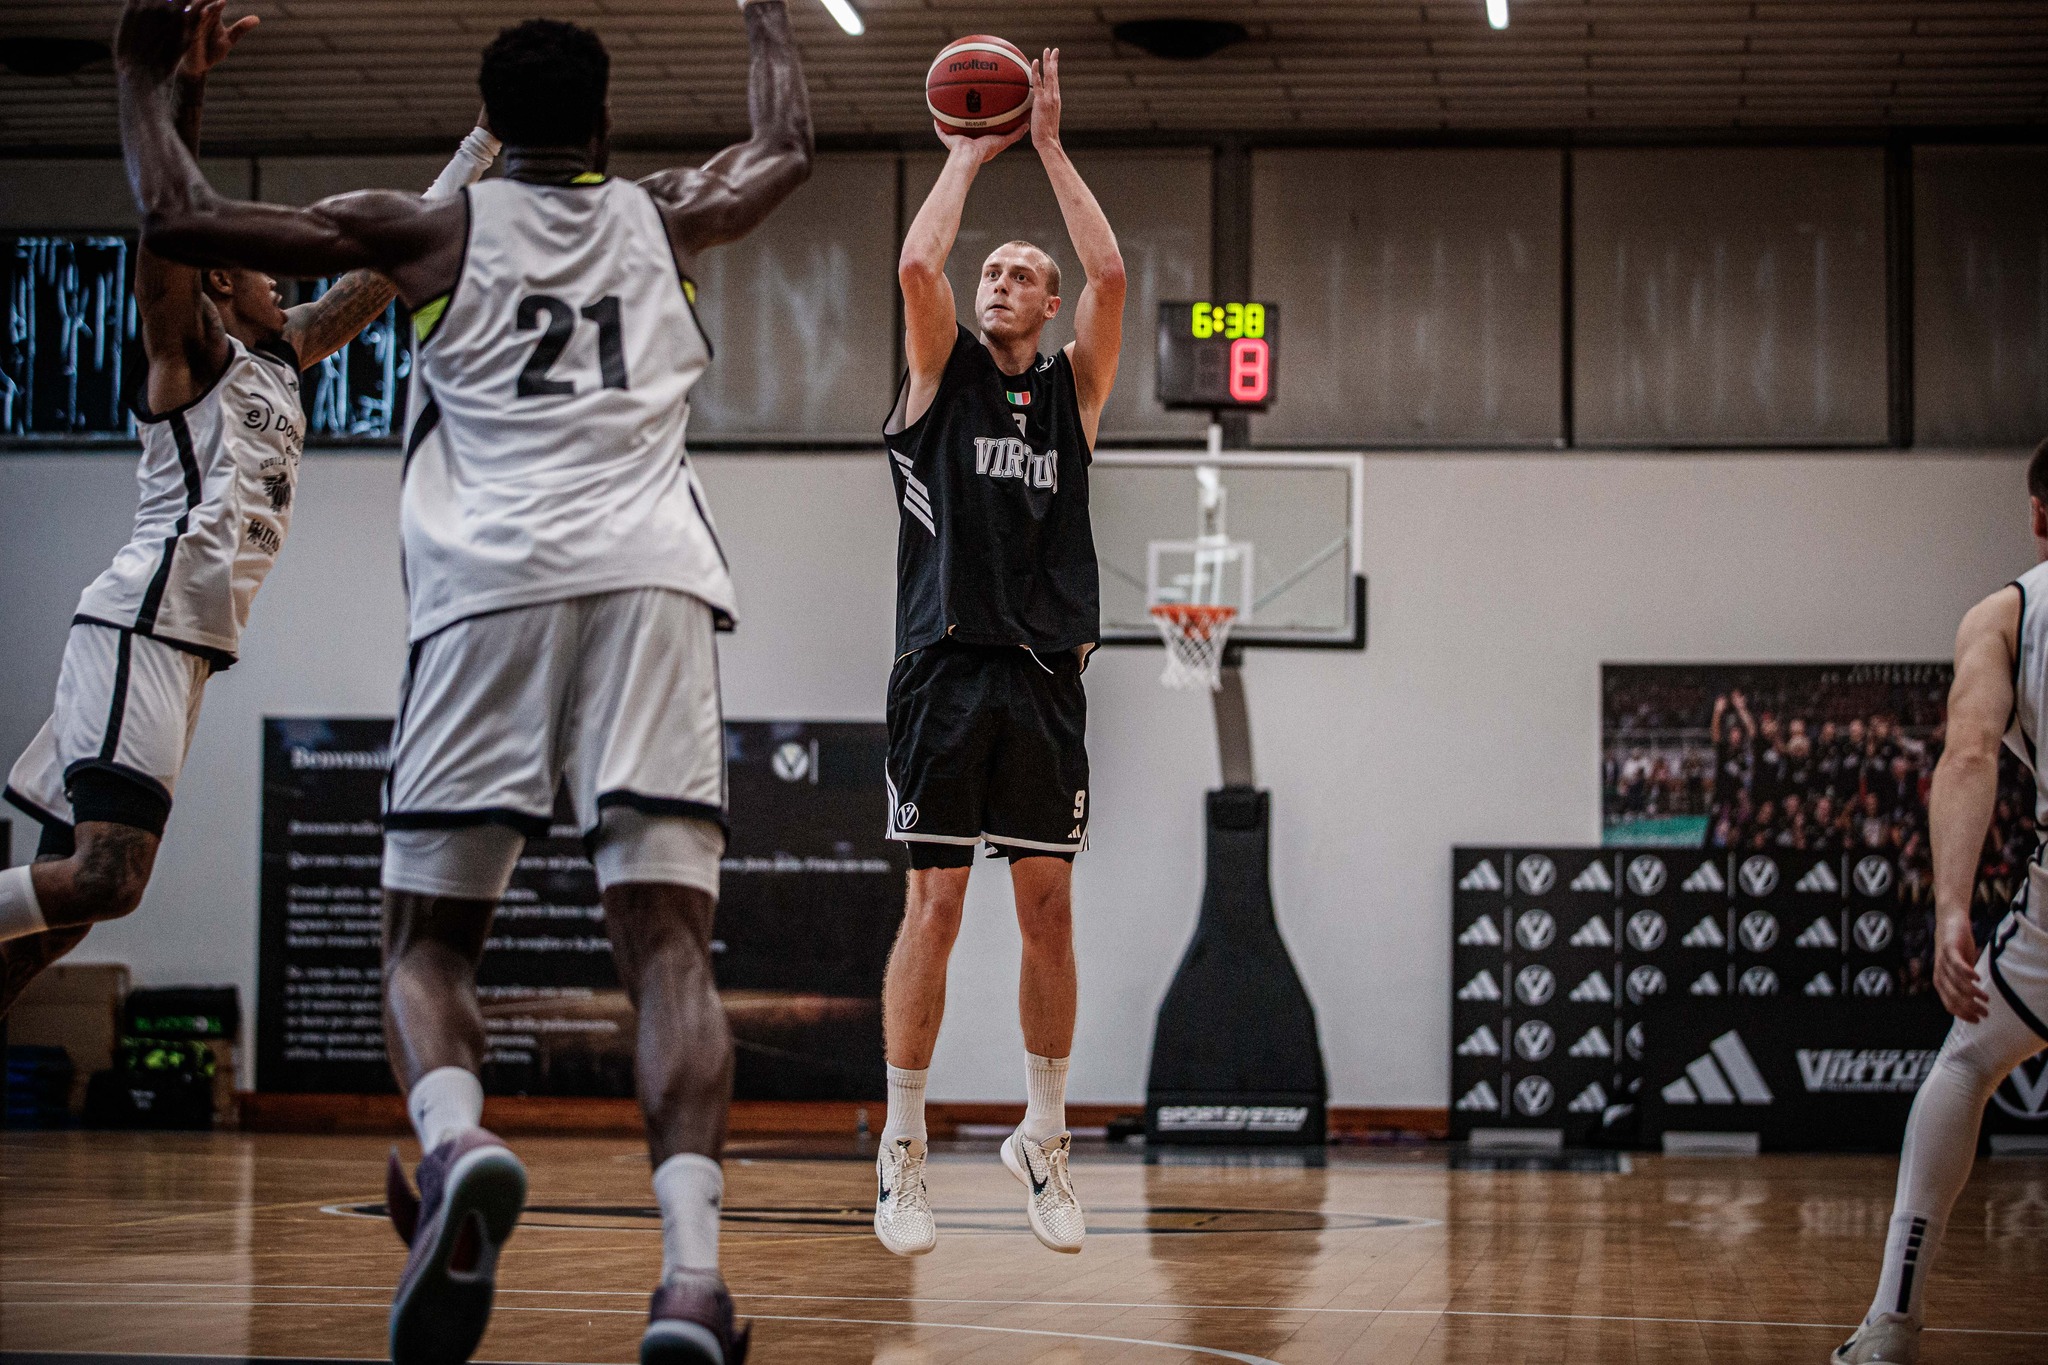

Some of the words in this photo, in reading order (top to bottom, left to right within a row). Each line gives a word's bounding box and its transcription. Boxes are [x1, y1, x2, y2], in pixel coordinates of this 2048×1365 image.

[949, 59, 999, 72] molten
[1191, 302, 1265, 339] 6:38
[517, 294, 629, 398] 21
[1229, 338, 1269, 402] 8
[1073, 790, 1086, 819] 9
